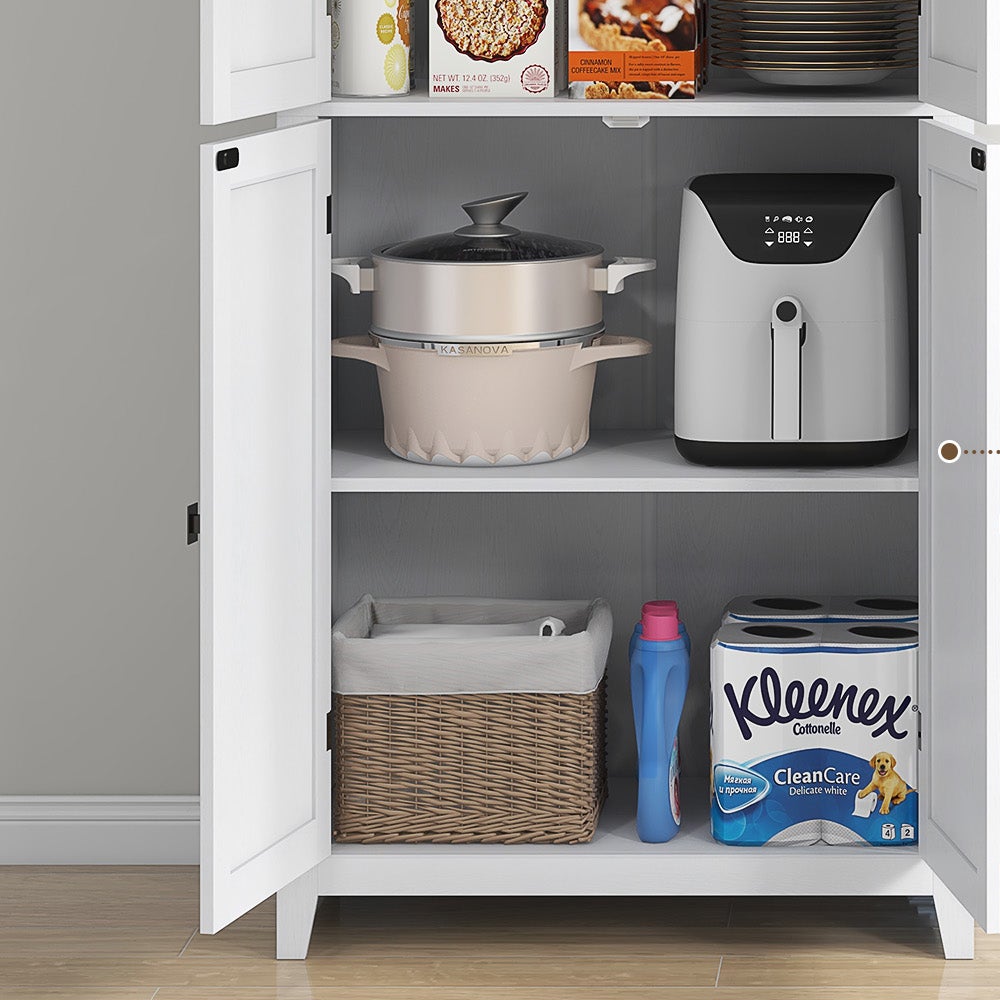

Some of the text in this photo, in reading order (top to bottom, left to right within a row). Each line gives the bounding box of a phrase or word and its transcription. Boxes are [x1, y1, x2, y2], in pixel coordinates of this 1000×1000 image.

[432, 74, 447, 82] NET
[433, 85, 460, 93] MAKES
[441, 345, 509, 354] KASANOVA
[724, 667, 911, 740] Kleenex
[792, 722, 841, 736] Cottonelle
[789, 785, 848, 796] Delicate white
[885, 829, 911, 837] 4 2
